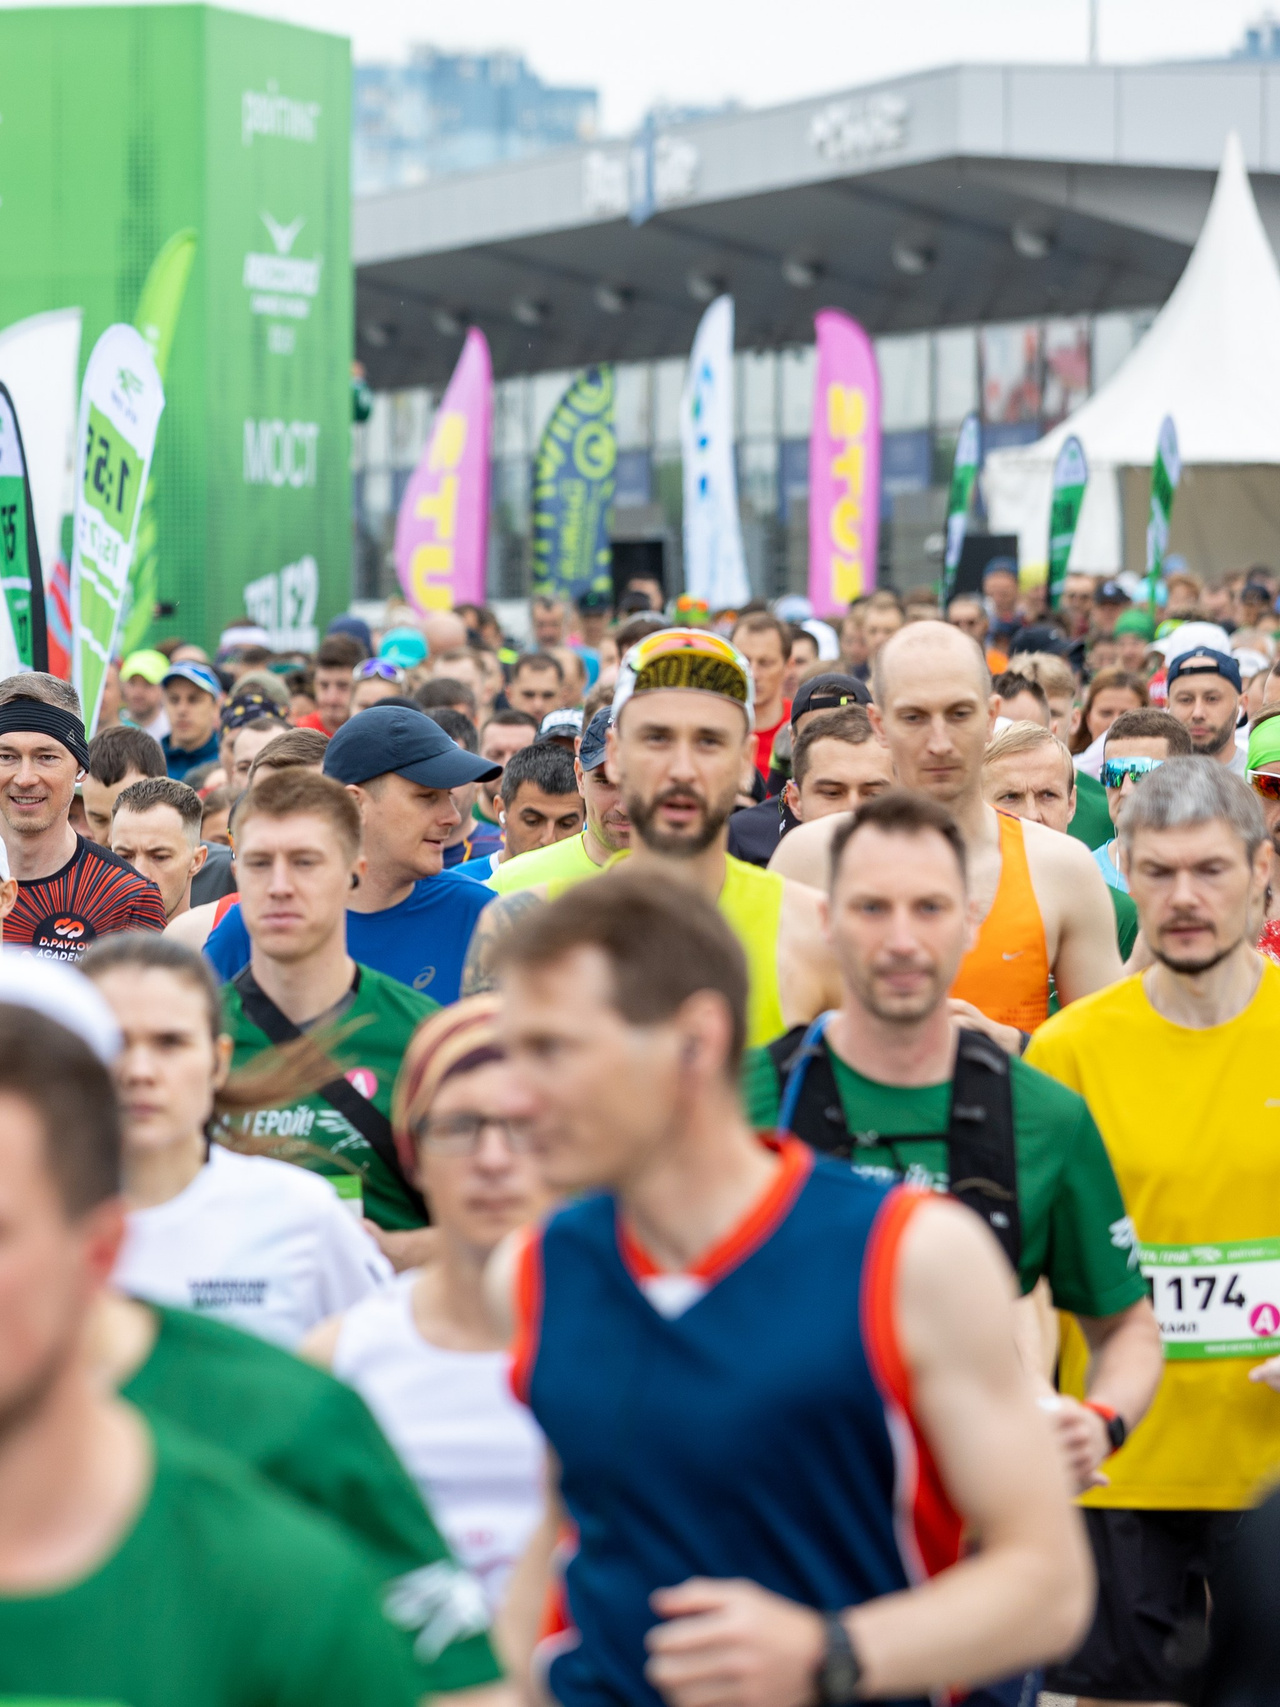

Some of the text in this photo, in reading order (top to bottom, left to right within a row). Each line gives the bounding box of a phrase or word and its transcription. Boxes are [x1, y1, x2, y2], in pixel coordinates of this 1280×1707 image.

[243, 418, 319, 488] МОСТ
[38, 936, 93, 952] D.PAVLOV
[36, 949, 88, 963] ACADEM
[1158, 1322, 1198, 1335] ХАИЛ
